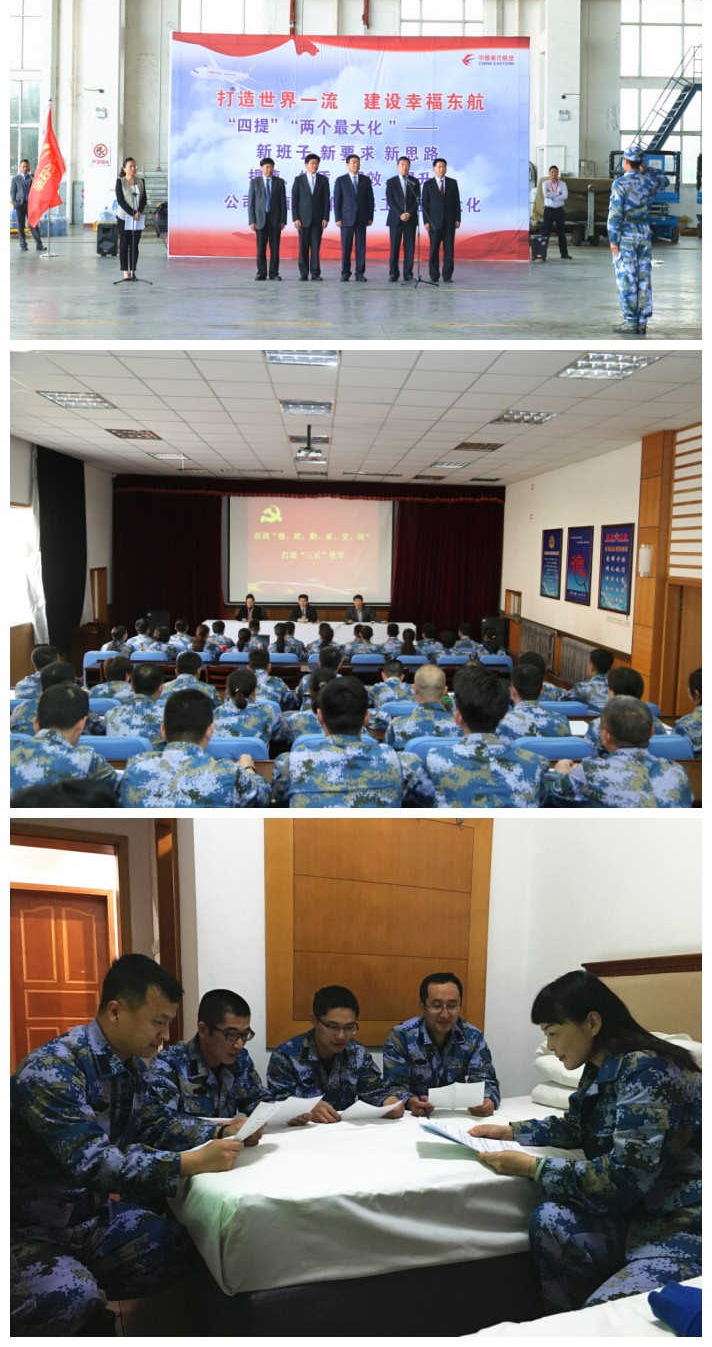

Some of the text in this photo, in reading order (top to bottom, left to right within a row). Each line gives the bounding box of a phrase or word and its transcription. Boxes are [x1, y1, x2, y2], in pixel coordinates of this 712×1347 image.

[217, 89, 485, 111] 打造世界一流 建设幸福东航
[256, 143, 439, 161] 新班子 新要求 新思路
